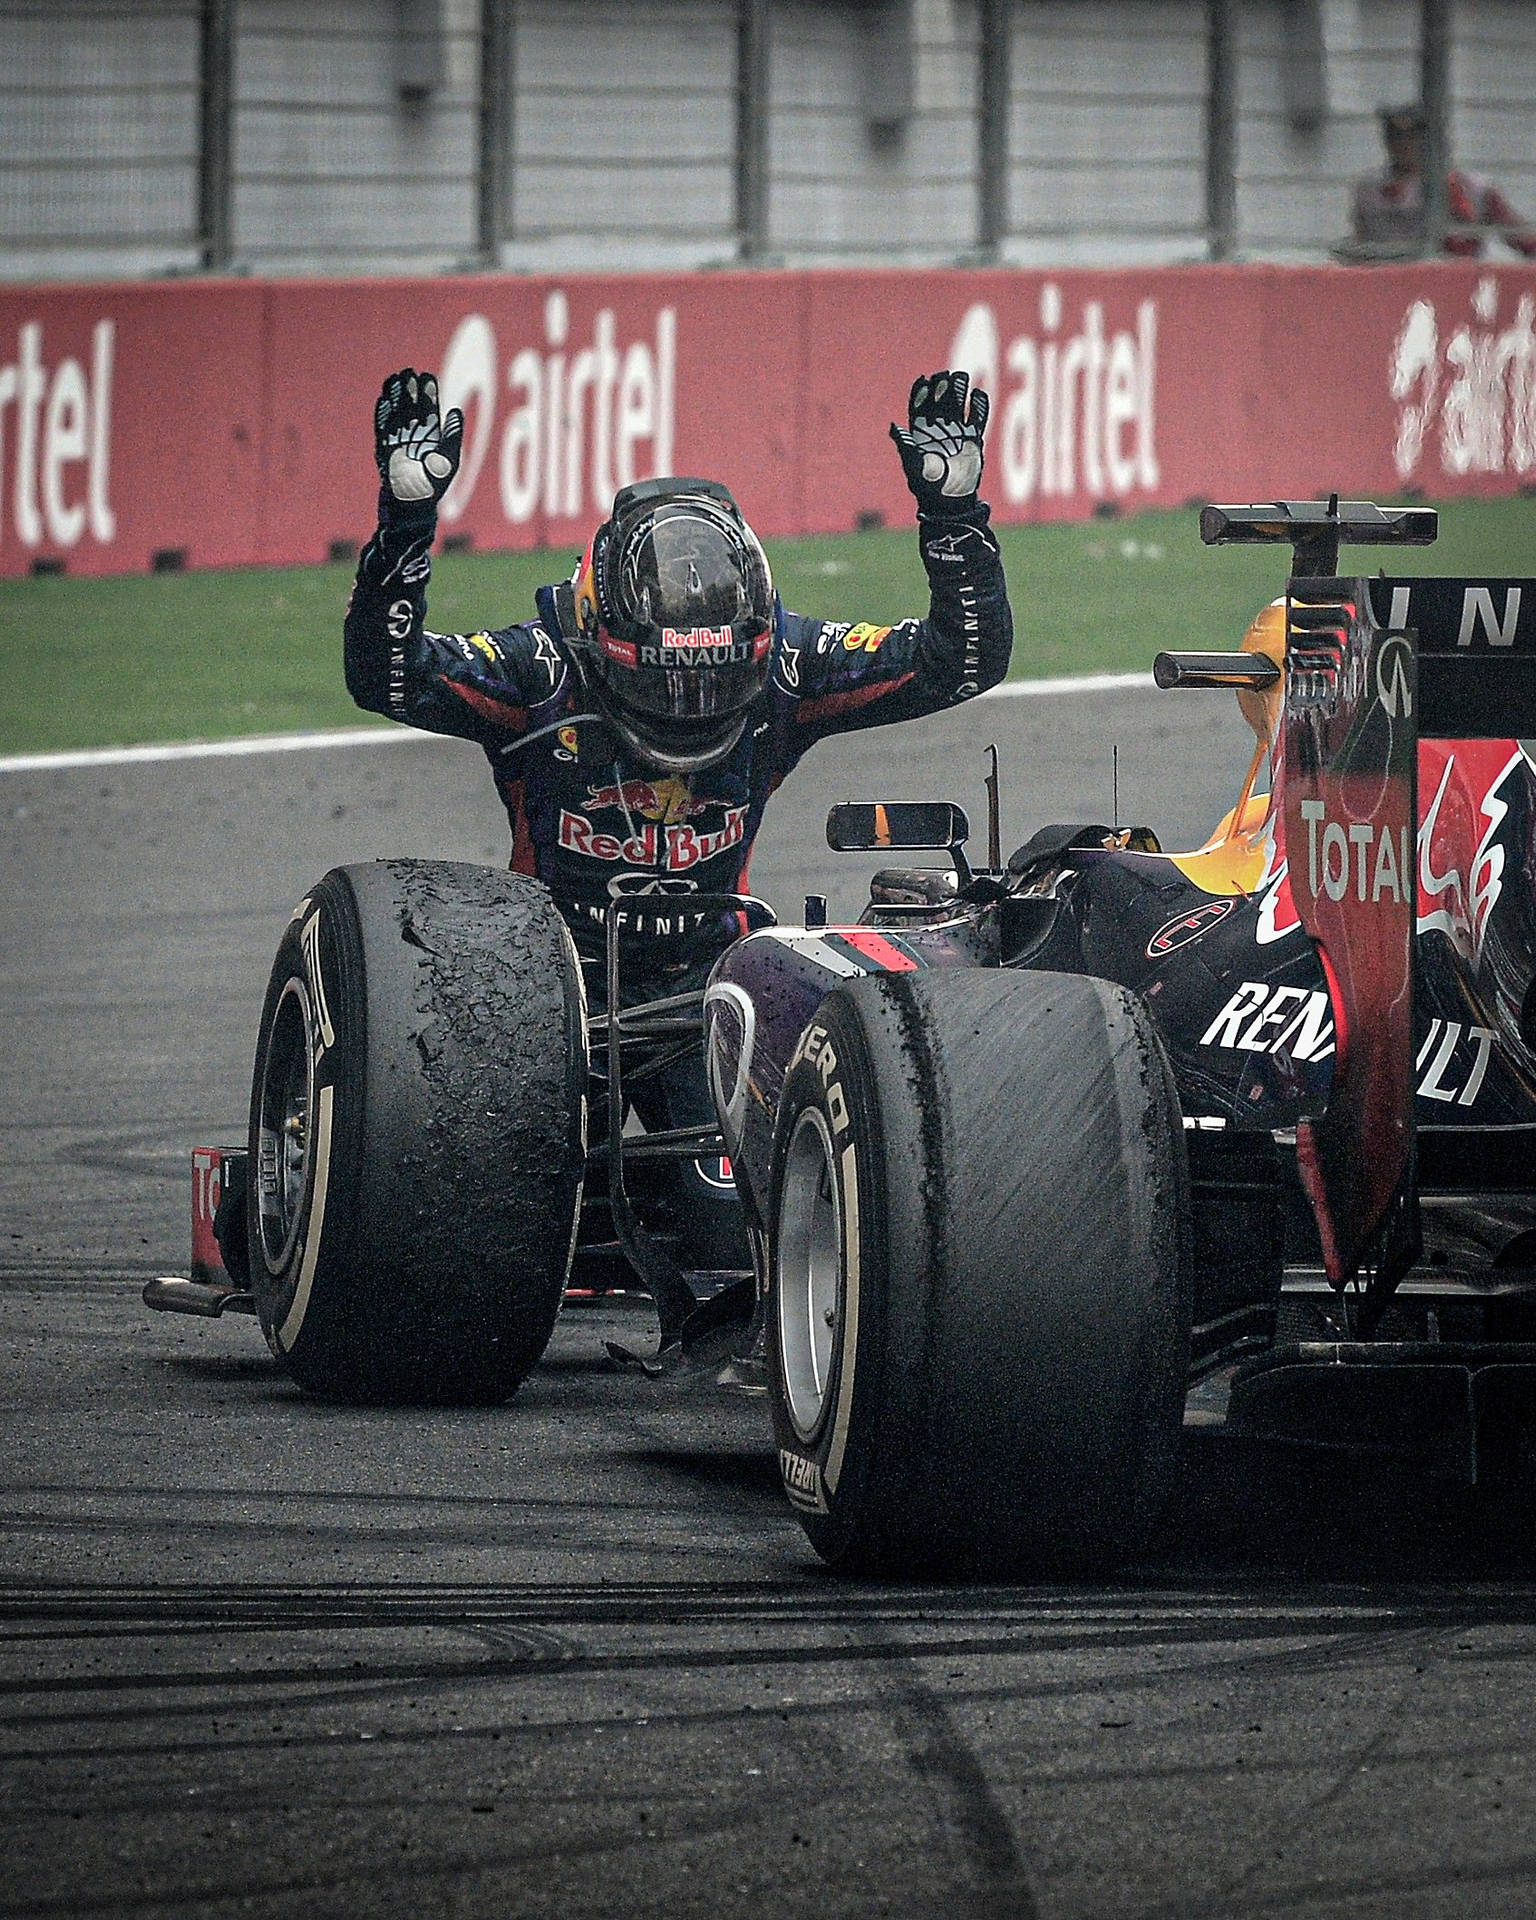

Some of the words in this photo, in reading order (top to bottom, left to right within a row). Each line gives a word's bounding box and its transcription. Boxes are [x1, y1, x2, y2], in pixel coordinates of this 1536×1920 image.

[502, 289, 676, 521] airtel
[1003, 284, 1159, 503] airtel
[641, 642, 751, 666] RENAULT
[558, 808, 657, 865] Red
[665, 803, 750, 872] Bull
